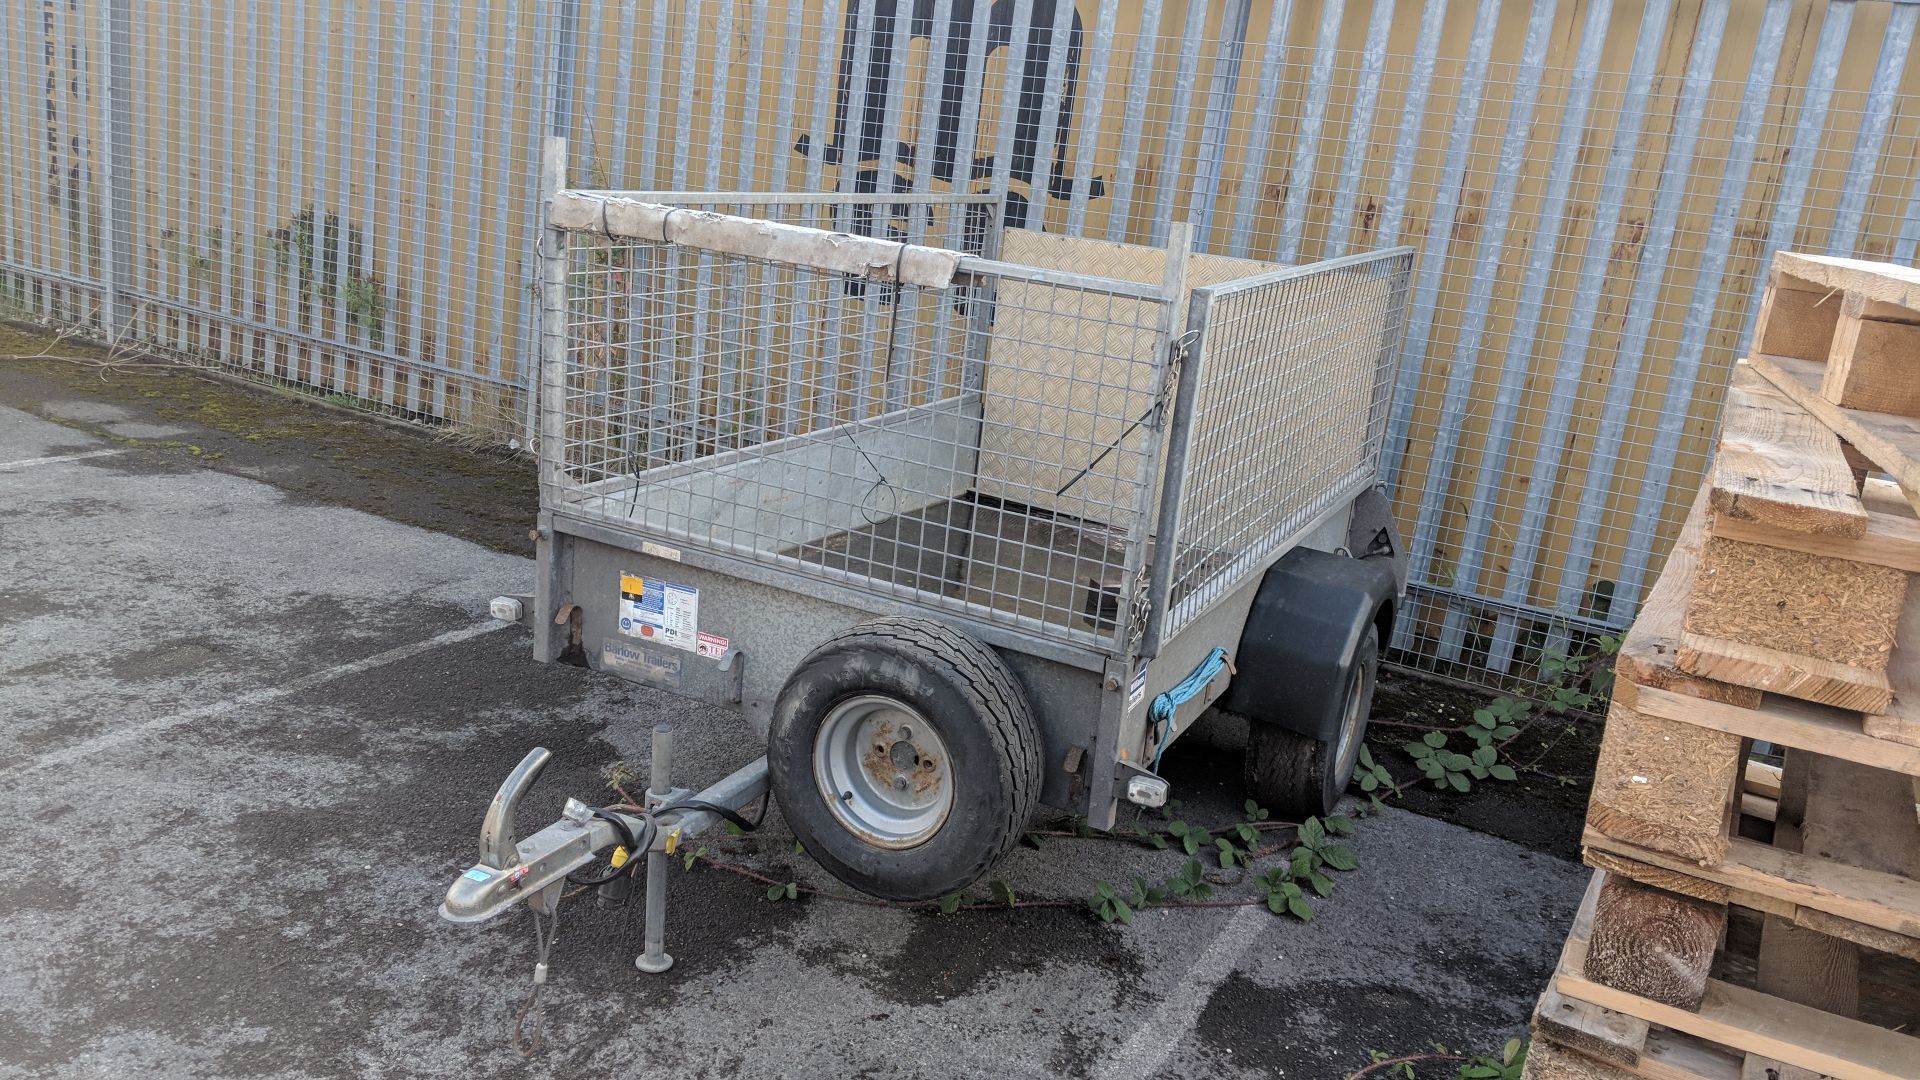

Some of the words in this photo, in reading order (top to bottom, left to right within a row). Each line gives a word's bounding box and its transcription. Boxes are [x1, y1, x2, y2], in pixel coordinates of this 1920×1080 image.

[665, 627, 678, 637] PDI
[698, 633, 727, 647] WARNING!
[604, 643, 641, 661] Barlow
[643, 652, 679, 672] Trailers
